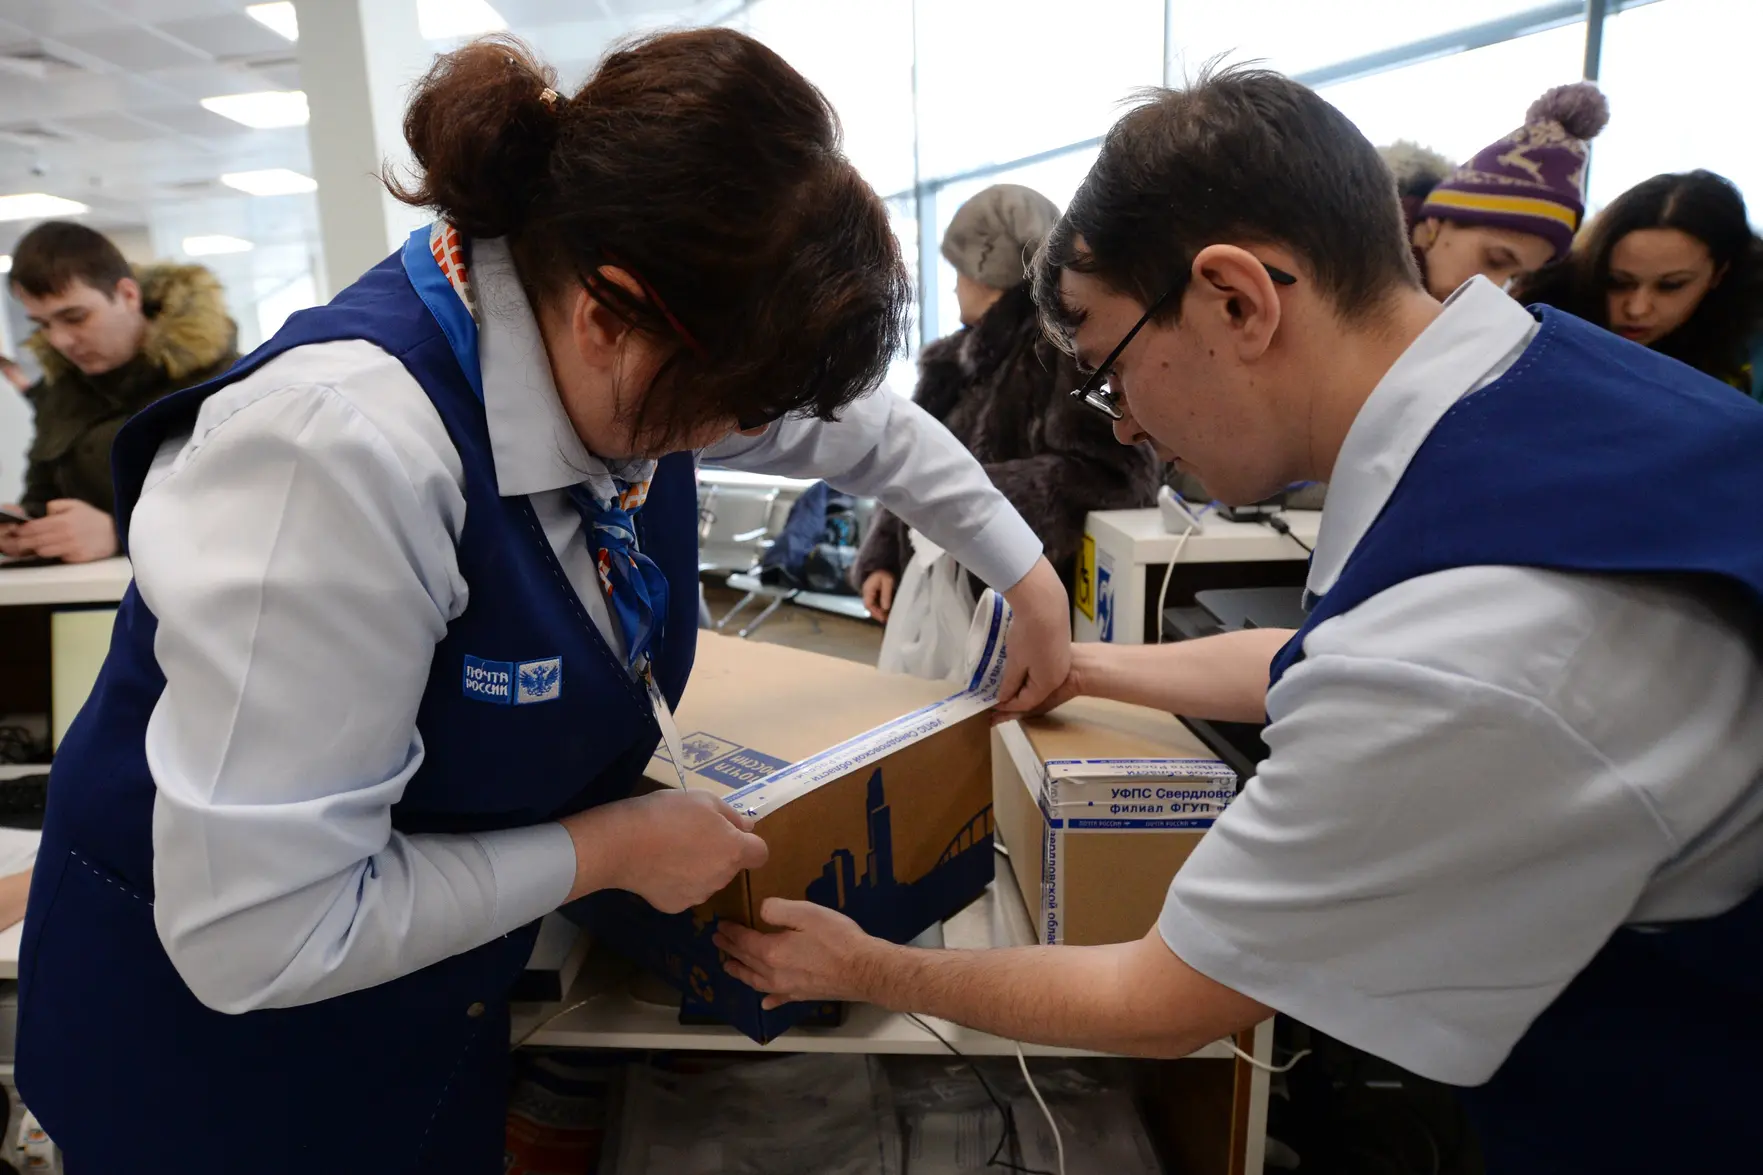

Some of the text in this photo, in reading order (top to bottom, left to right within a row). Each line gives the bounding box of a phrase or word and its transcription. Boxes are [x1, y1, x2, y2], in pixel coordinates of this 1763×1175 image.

[466, 665, 509, 683] ПОЧТА
[466, 678, 508, 696] РОССИИ
[920, 718, 945, 734] УФПС
[853, 727, 919, 763] Свердловской
[812, 759, 853, 782] области
[1111, 788, 1152, 799] УФПС
[1110, 803, 1163, 815] филиал
[1170, 803, 1210, 813] ФГУП
